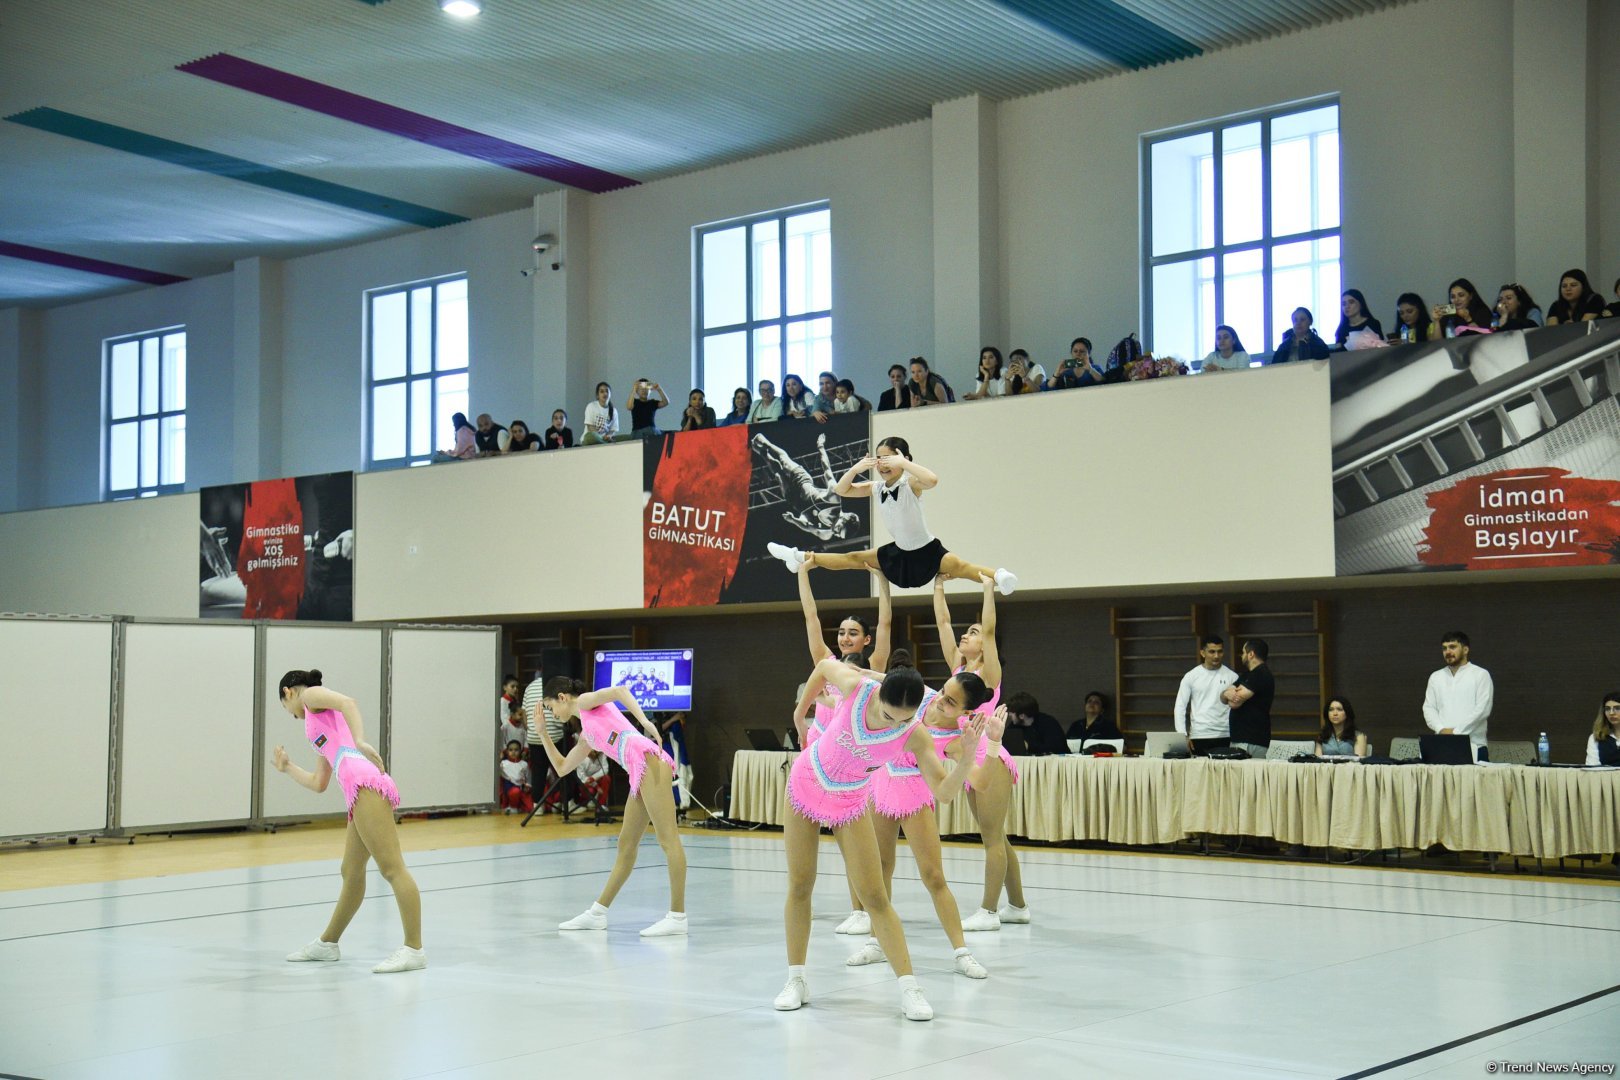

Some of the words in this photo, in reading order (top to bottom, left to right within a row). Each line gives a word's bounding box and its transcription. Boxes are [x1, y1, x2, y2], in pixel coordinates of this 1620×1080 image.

[1479, 484, 1564, 508] İdman
[651, 501, 726, 532] BATUT
[1463, 508, 1589, 526] Gimnastikadan
[246, 522, 300, 538] Gimnastika
[648, 525, 735, 552] GİMNASTİKASI
[1475, 527, 1579, 550] Başlayır
[247, 555, 299, 572] gəlmişsiniz
